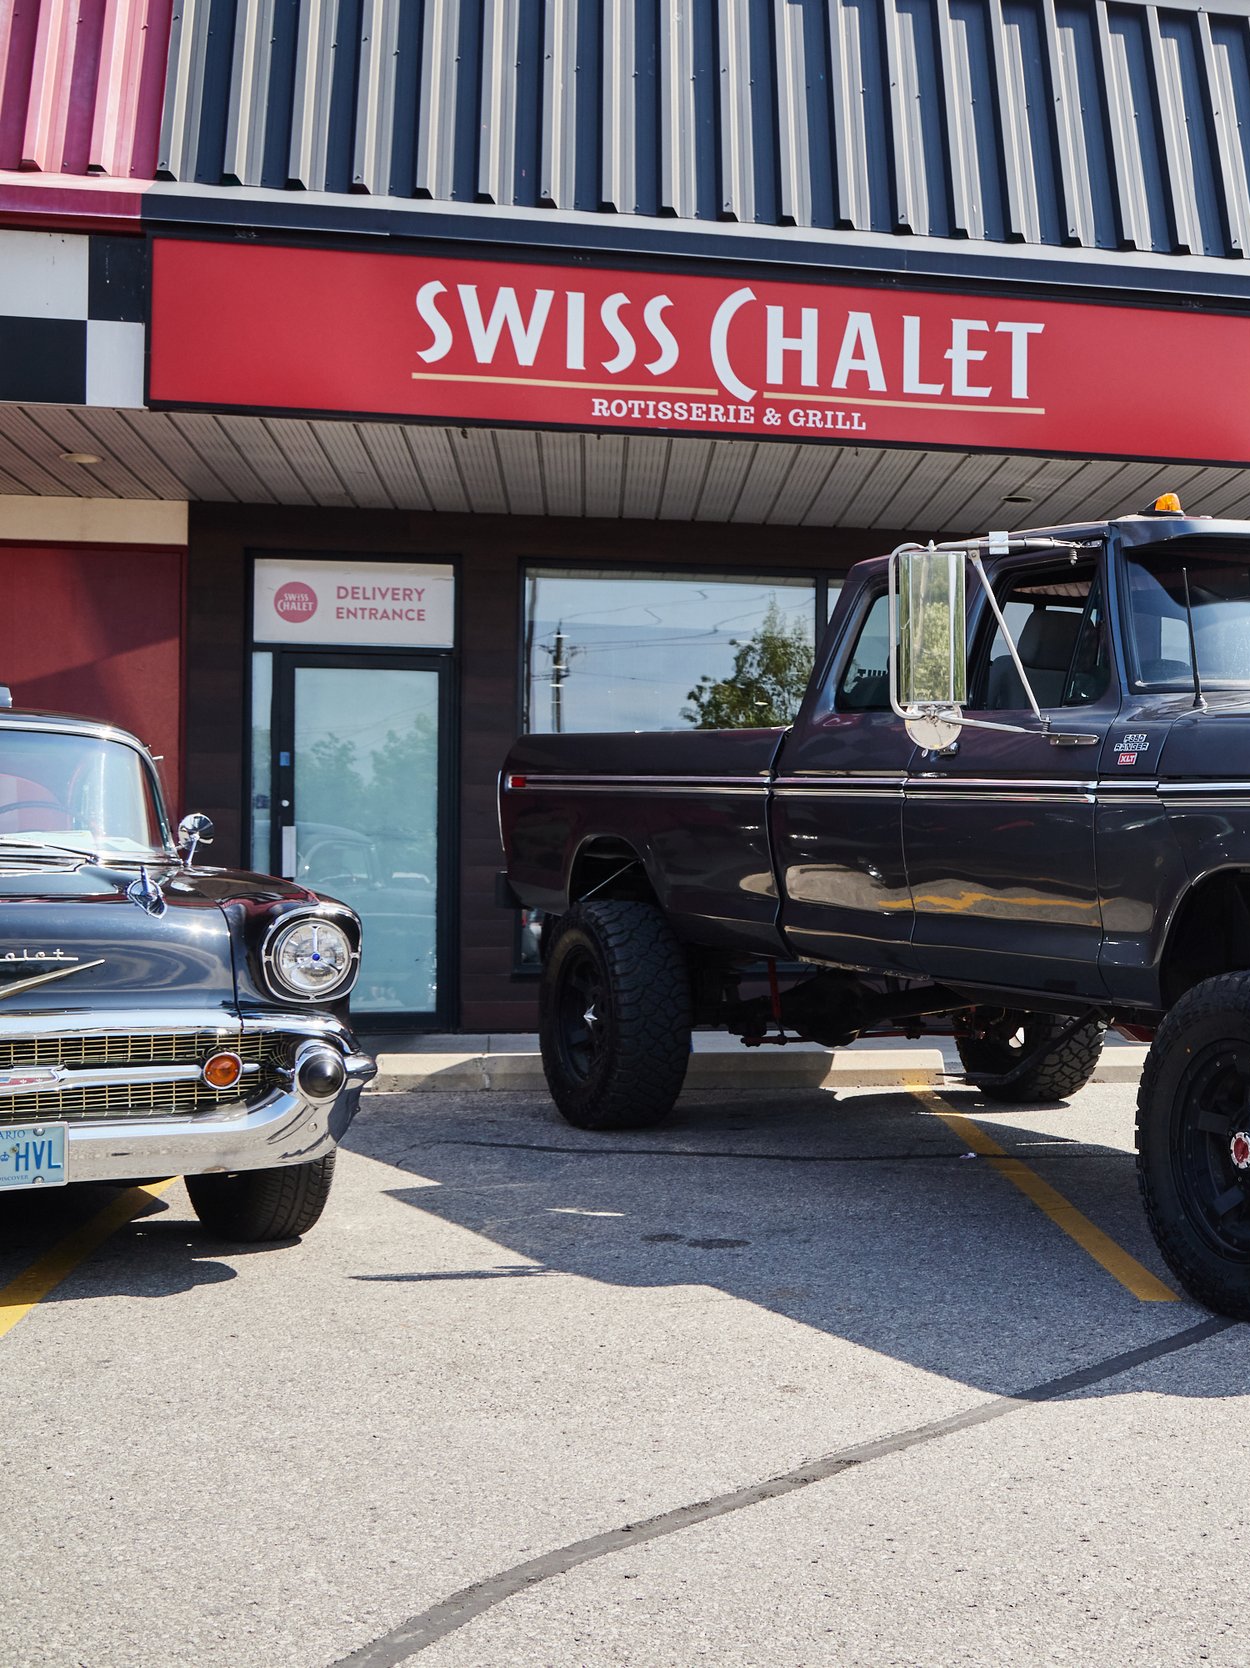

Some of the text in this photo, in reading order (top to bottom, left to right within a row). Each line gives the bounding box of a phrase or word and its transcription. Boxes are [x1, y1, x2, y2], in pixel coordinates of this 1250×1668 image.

[416, 280, 1045, 402] SWISS CHALET
[592, 398, 866, 430] ROTISSERIE & GRILL
[336, 586, 425, 602] DELIVERY
[277, 599, 314, 612] CHALET
[336, 607, 426, 621] ENTRANCE
[1114, 742, 1149, 751] RANGER
[15, 1140, 61, 1172] HVL
